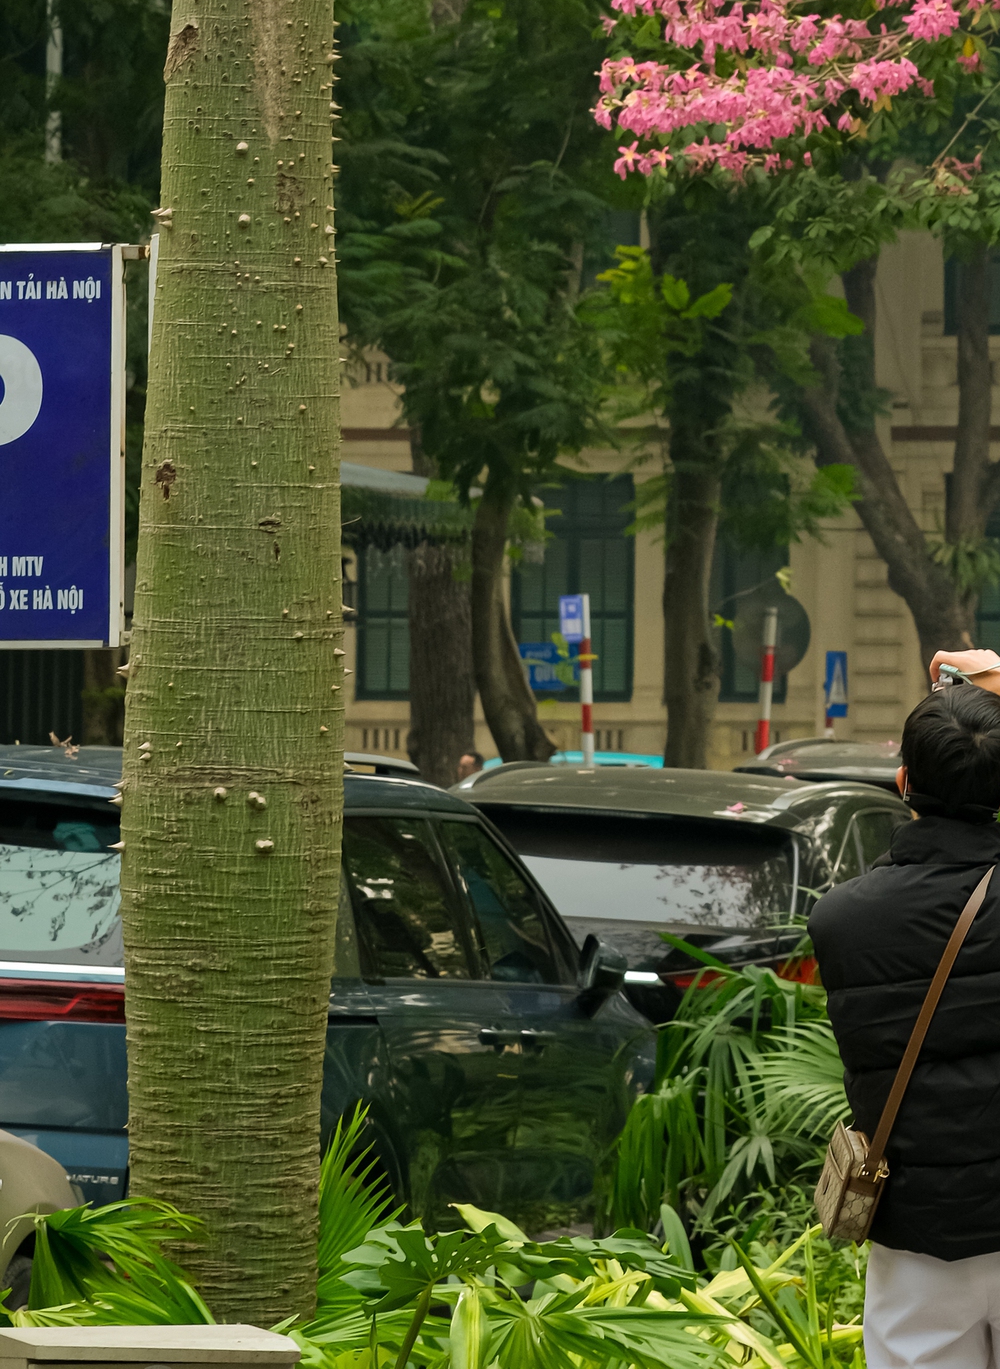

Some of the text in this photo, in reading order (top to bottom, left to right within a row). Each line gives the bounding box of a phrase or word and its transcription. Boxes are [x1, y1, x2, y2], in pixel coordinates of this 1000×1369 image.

[16, 273, 42, 300] TẢI
[46, 276, 68, 300] HÀ
[72, 276, 101, 303] NỘI
[12, 556, 44, 577] MTV
[9, 589, 29, 610] XE
[32, 585, 53, 610] HÀ
[57, 584, 84, 614] NỘI
